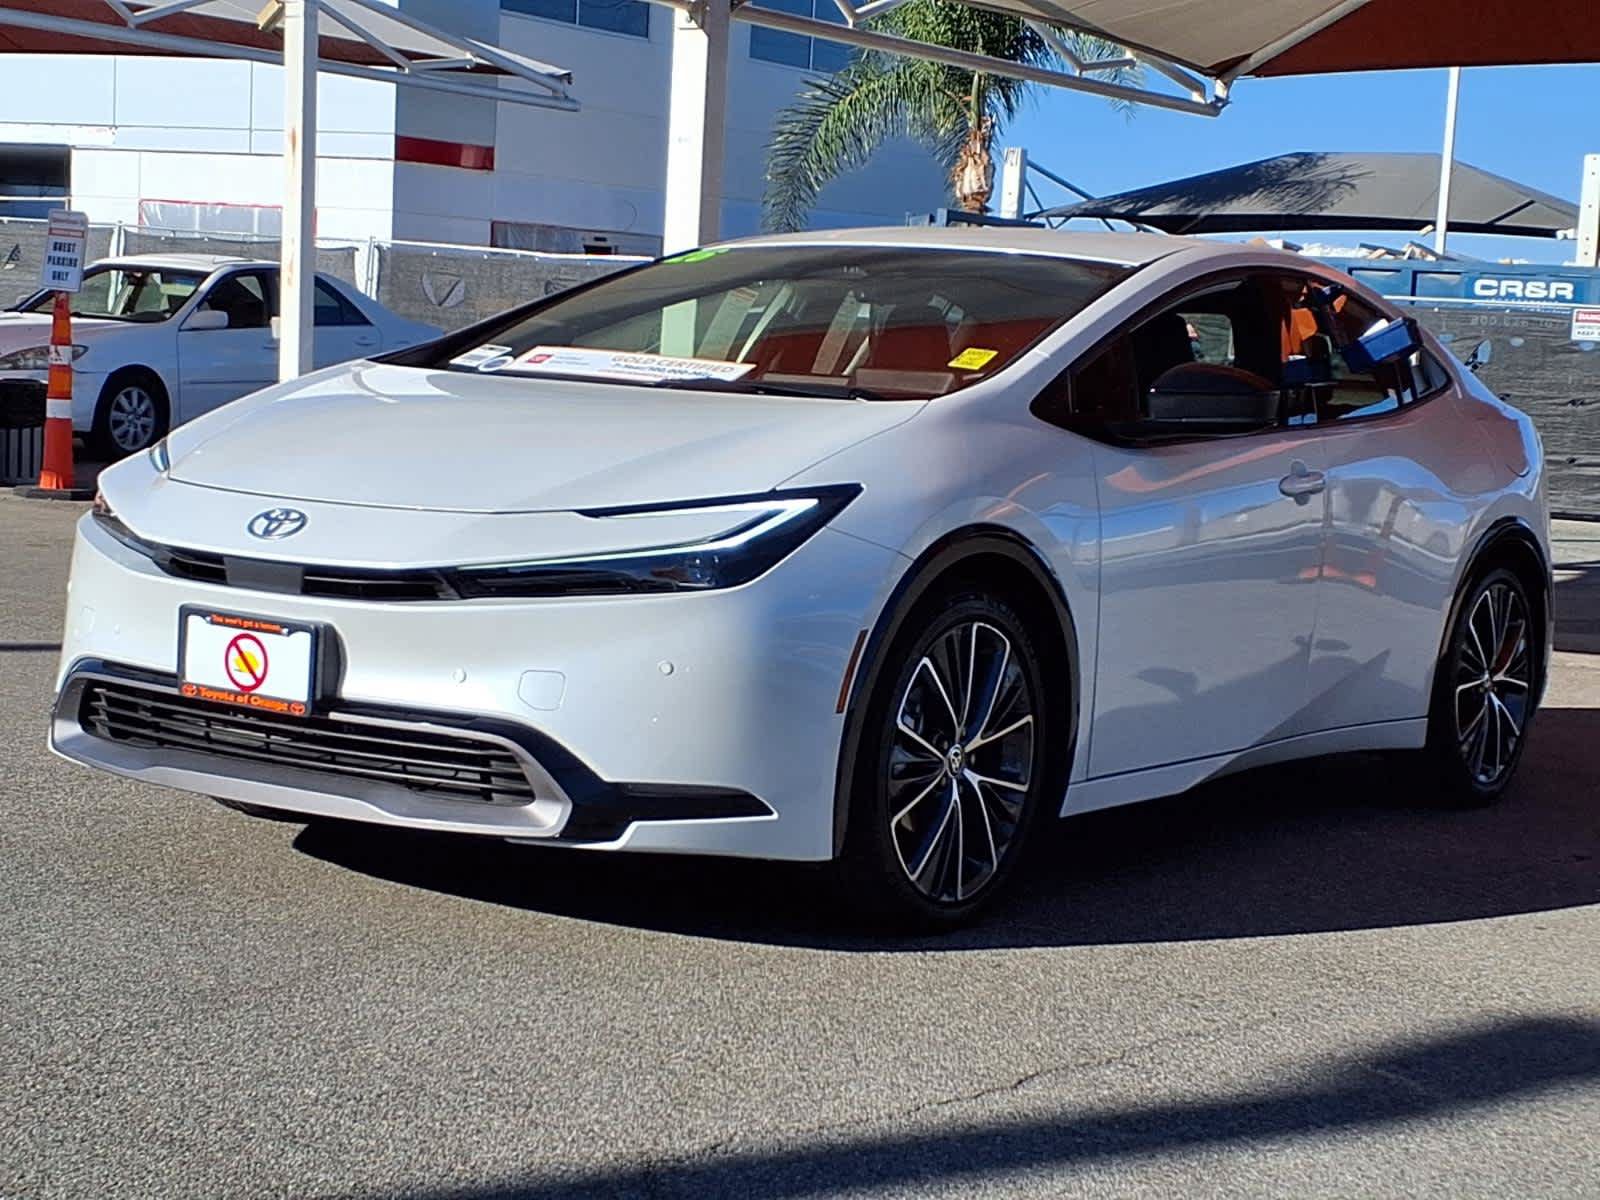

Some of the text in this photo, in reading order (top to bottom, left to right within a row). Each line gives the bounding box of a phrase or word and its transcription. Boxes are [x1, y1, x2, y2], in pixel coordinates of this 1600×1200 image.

[53, 241, 76, 252] GUEST
[47, 255, 78, 267] PARKING
[52, 270, 69, 280] ONLY
[1473, 279, 1574, 300] CR&R
[611, 355, 736, 373] GOLD CERTIFIED
[199, 686, 289, 711] Toyota of Orange
